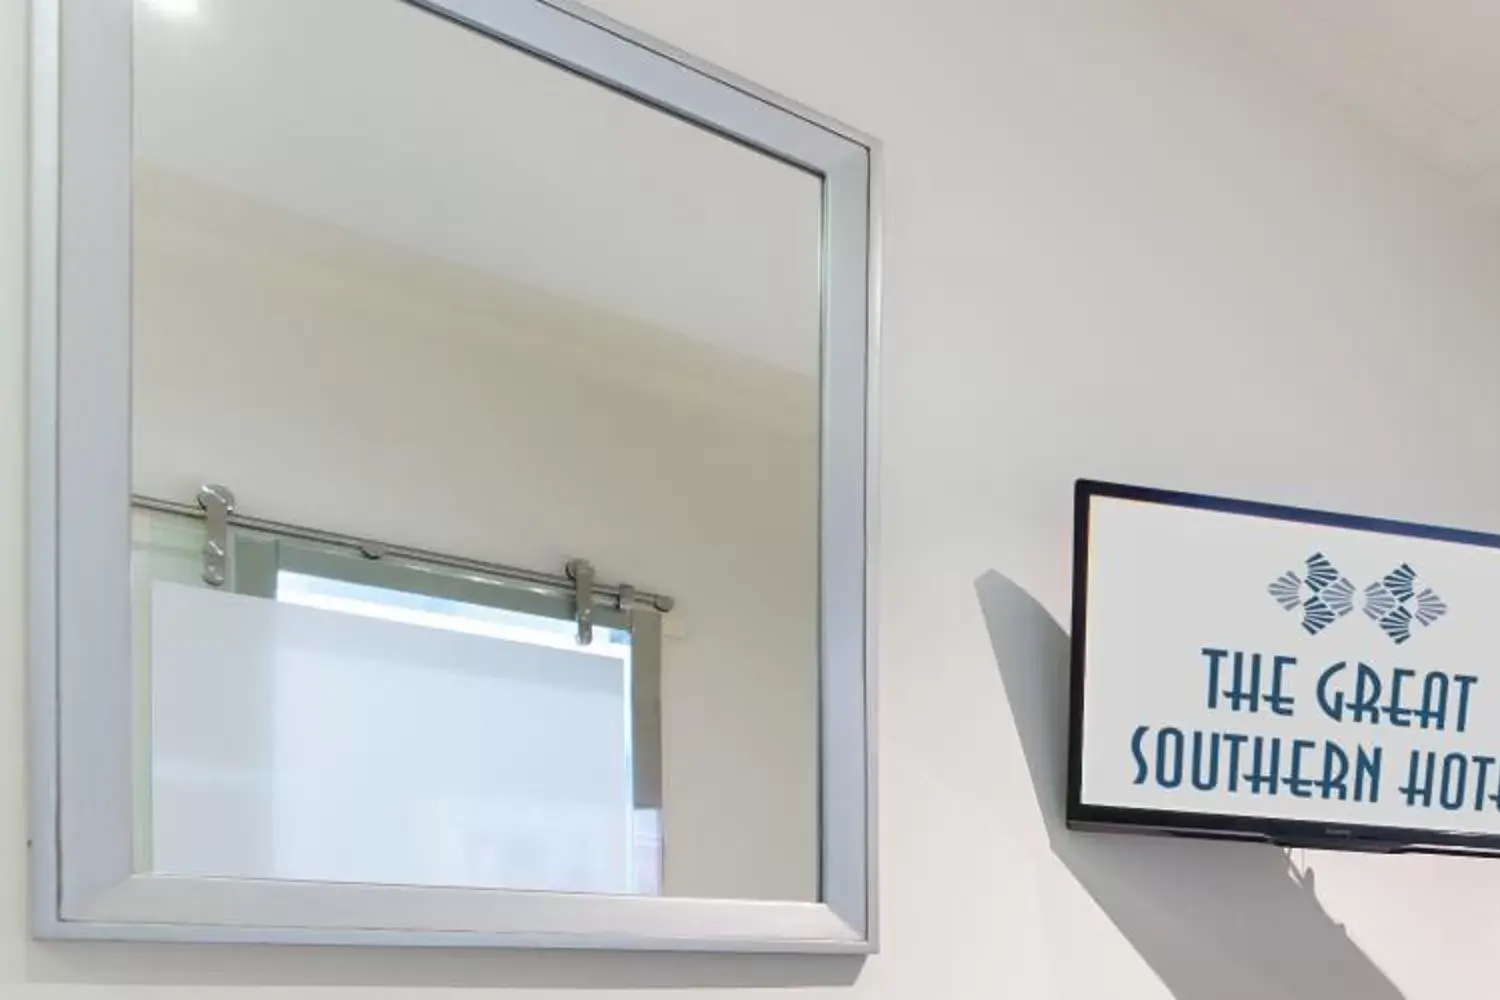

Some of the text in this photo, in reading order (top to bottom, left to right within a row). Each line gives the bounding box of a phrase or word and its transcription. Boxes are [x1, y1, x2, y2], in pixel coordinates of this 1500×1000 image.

[1201, 648, 1478, 733] THE GREAT
[1131, 725, 1382, 803] SOUTHERN
